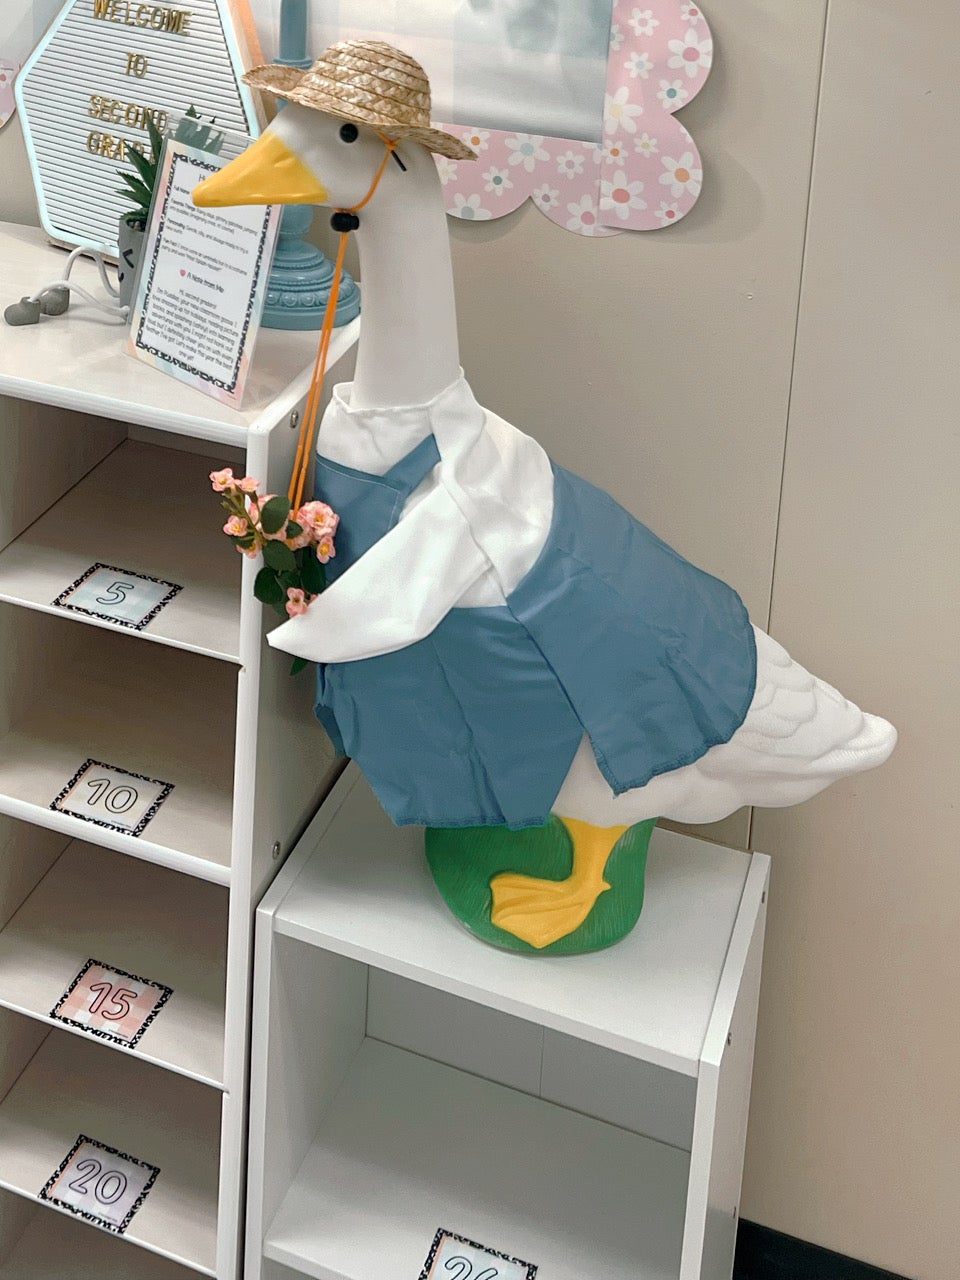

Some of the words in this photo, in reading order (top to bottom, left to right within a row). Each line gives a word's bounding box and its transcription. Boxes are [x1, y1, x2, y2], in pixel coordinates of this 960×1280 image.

[125, 51, 148, 79] TO
[87, 95, 169, 135] SECOND
[96, 581, 127, 606] 5
[86, 778, 139, 814] 10
[88, 982, 139, 1020] 15
[69, 1158, 128, 1206] 20
